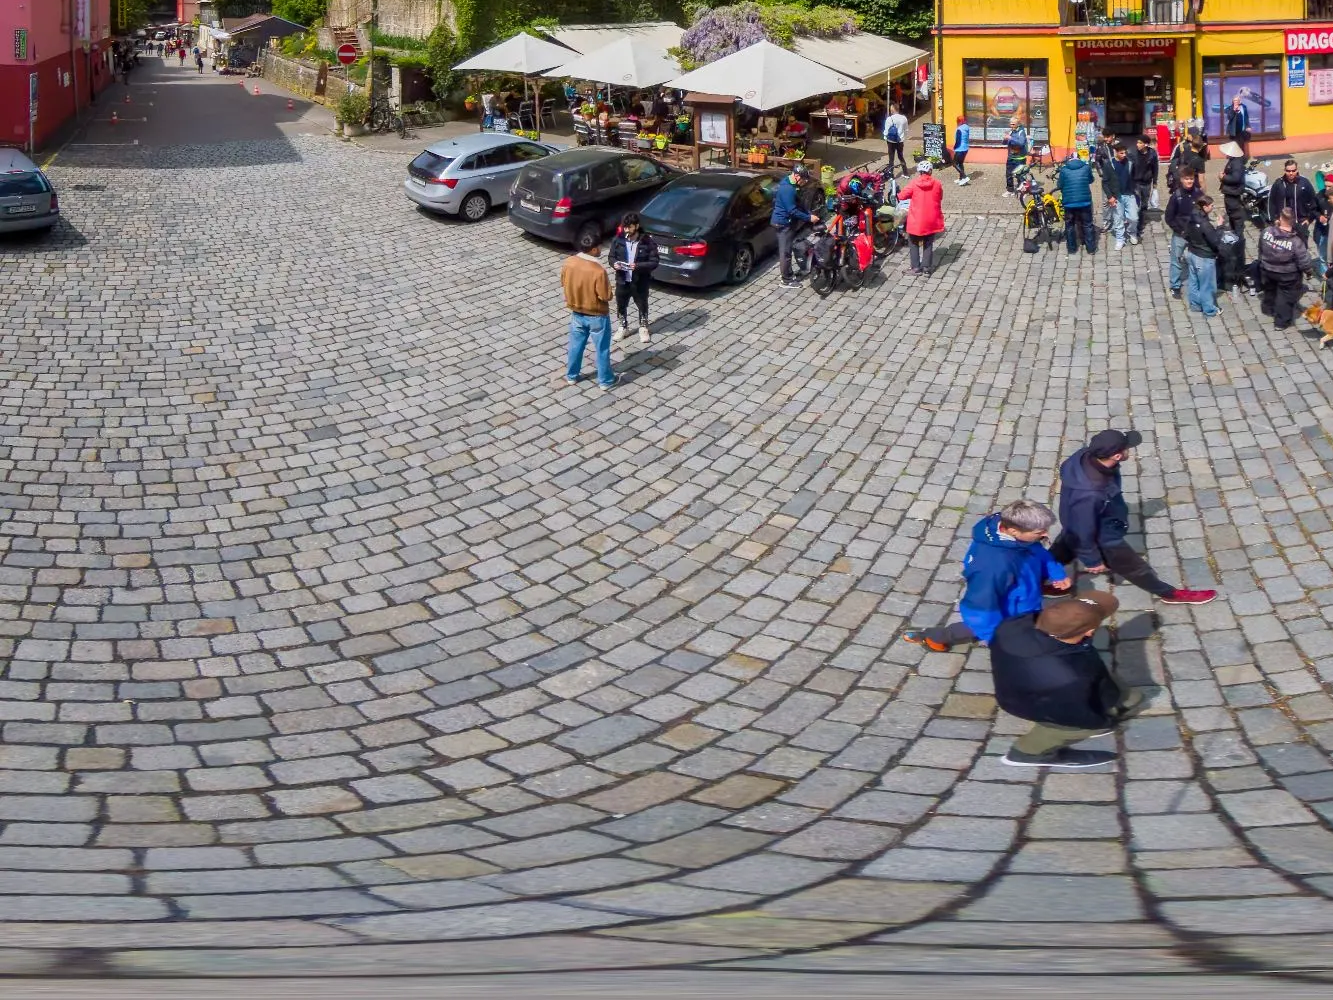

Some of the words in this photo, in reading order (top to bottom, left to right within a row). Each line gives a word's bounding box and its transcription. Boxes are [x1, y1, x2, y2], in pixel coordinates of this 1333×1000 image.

[1077, 39, 1133, 49] DRAGON
[1137, 38, 1174, 48] SHOP
[1292, 56, 1301, 70] P
